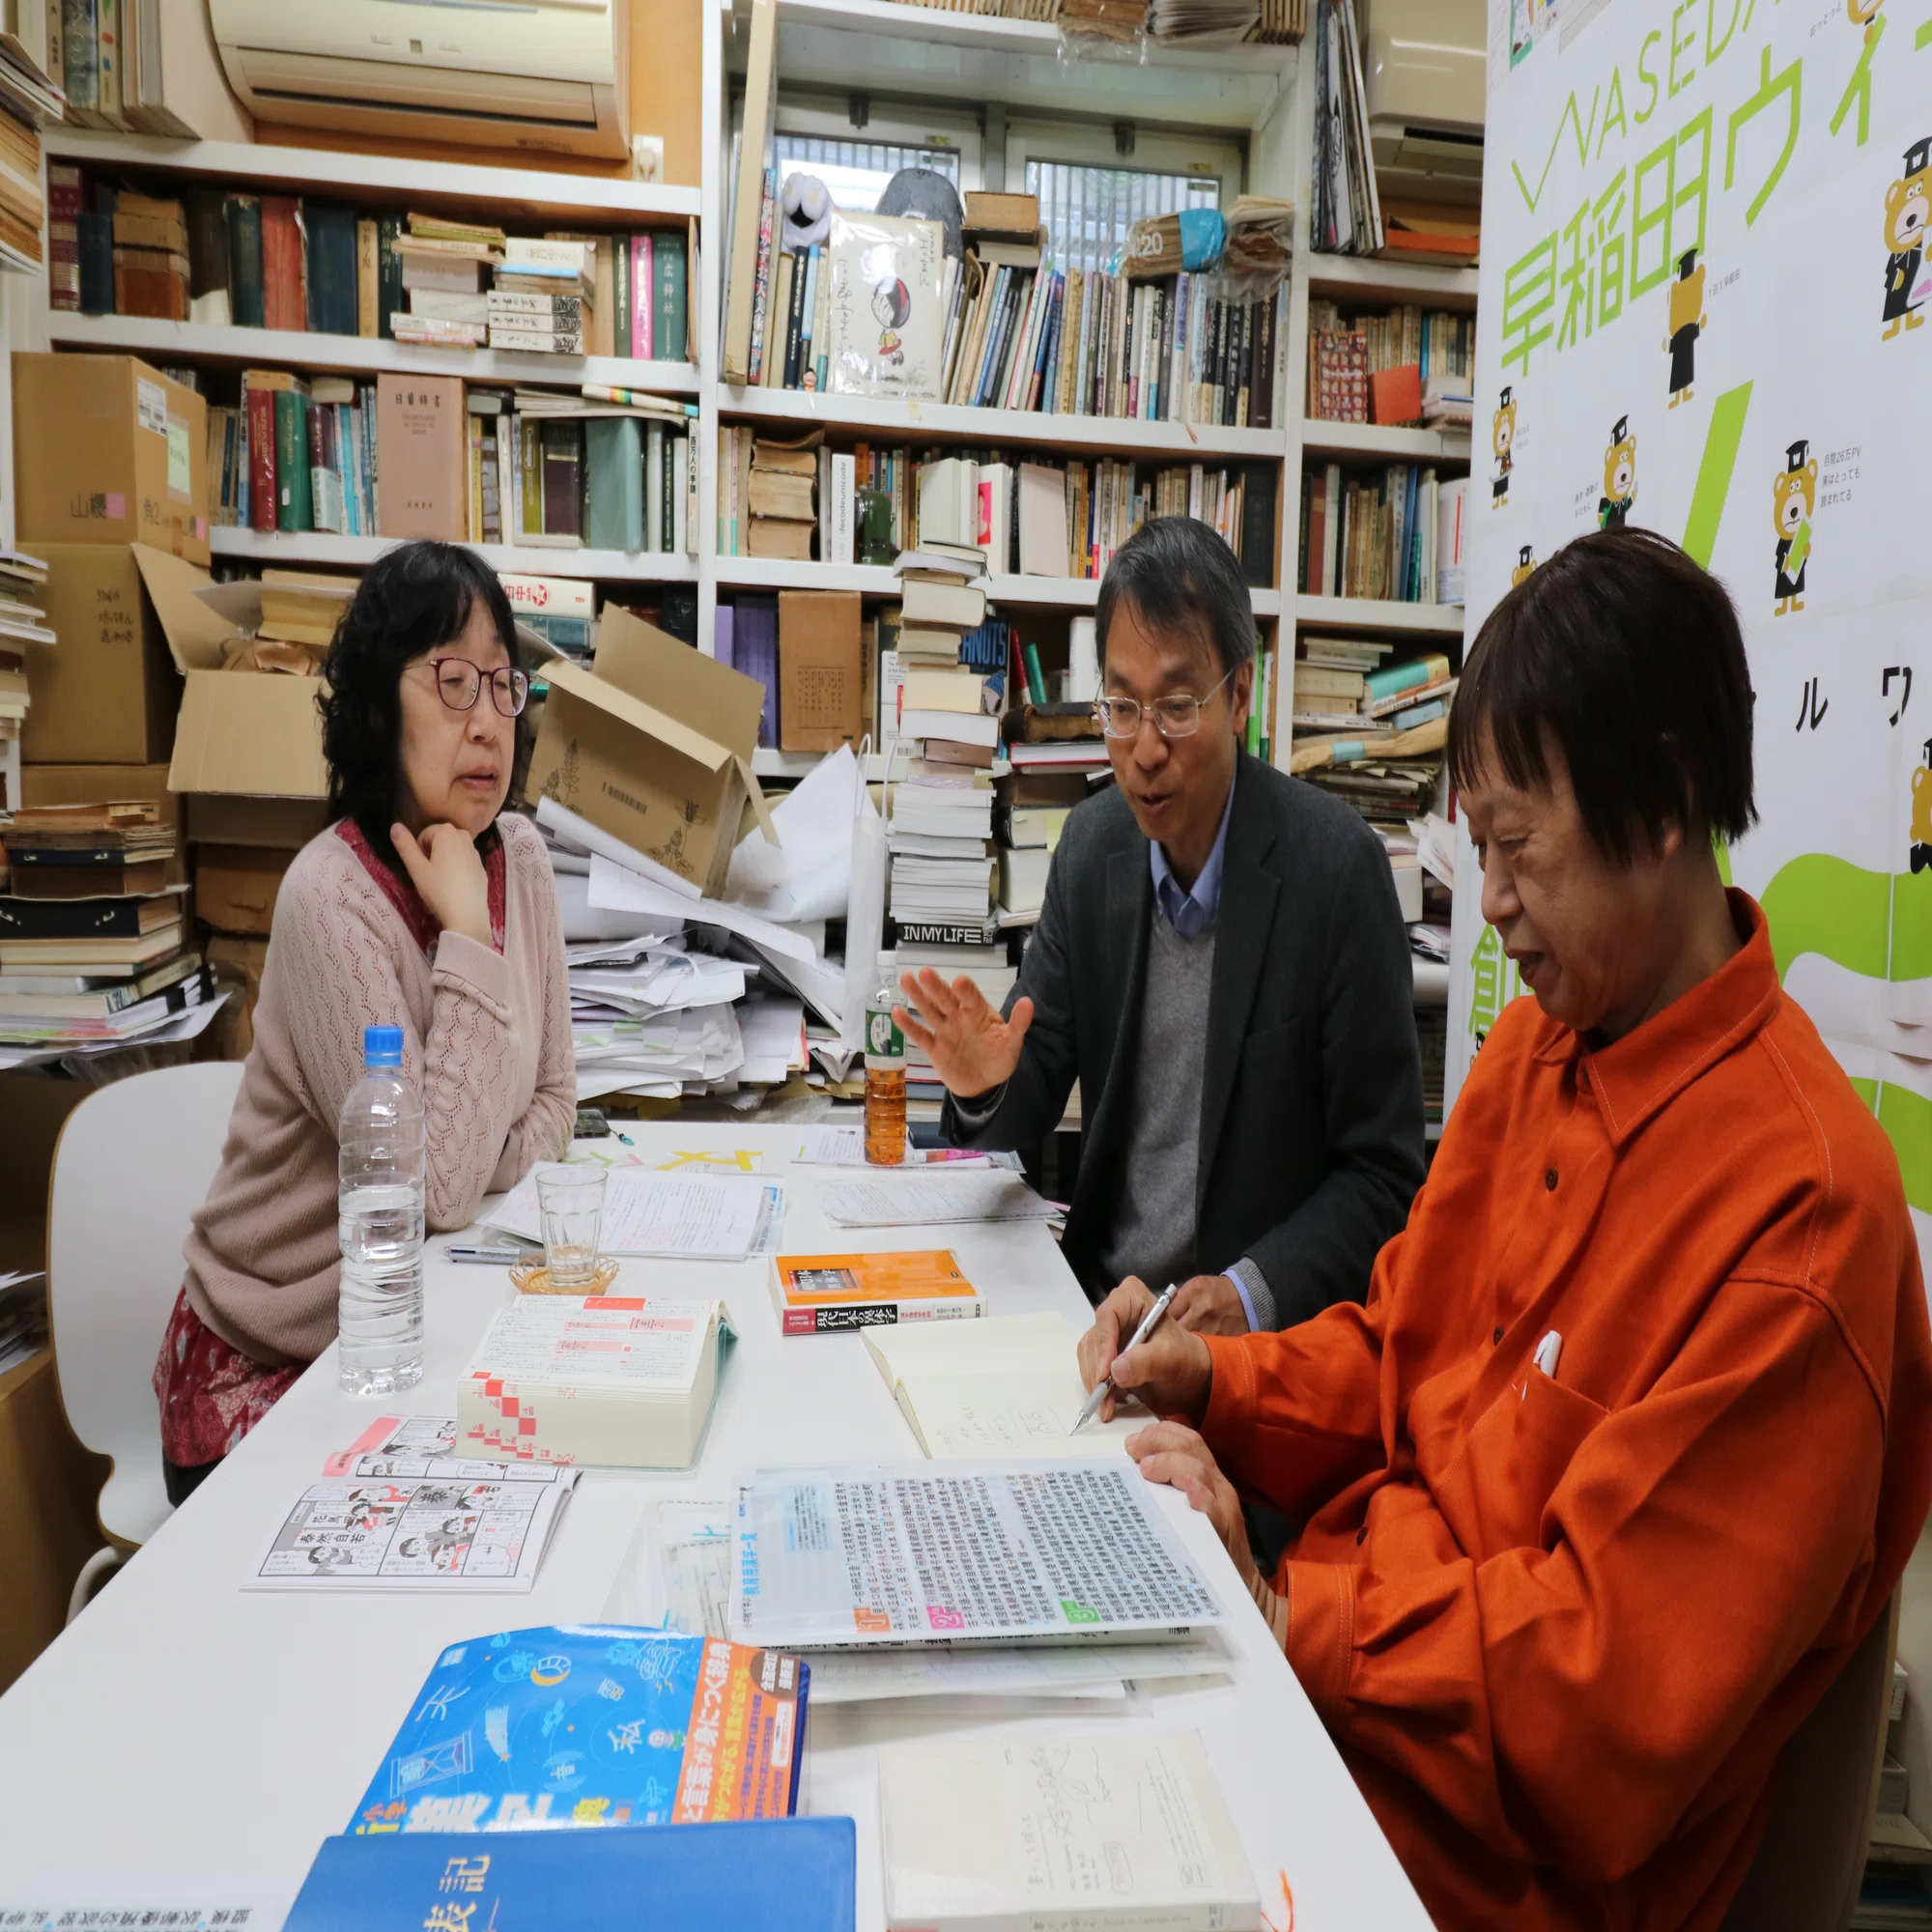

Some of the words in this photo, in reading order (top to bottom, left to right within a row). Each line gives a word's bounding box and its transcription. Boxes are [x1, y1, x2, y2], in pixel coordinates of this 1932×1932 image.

[1501, 13, 1932, 378] 早稲田ウィ
[958, 622, 1008, 666] ANUTS
[903, 925, 920, 940] IN
[922, 925, 943, 941] MY
[944, 926, 982, 944] LIFE
[817, 1307, 897, 1328] 現代日本の異体字
[299, 1533, 366, 1545] 泰然自若
[741, 1531, 761, 1597] 教育用漢字一覧
[760, 1651, 779, 1692] 全面改訂
[778, 1658, 795, 1690] 最新版
[415, 1685, 470, 1723] 天
[606, 1719, 645, 1754] 私
[681, 1642, 732, 1823] と言葉が身につく辞典
[551, 1764, 576, 1780] 音
